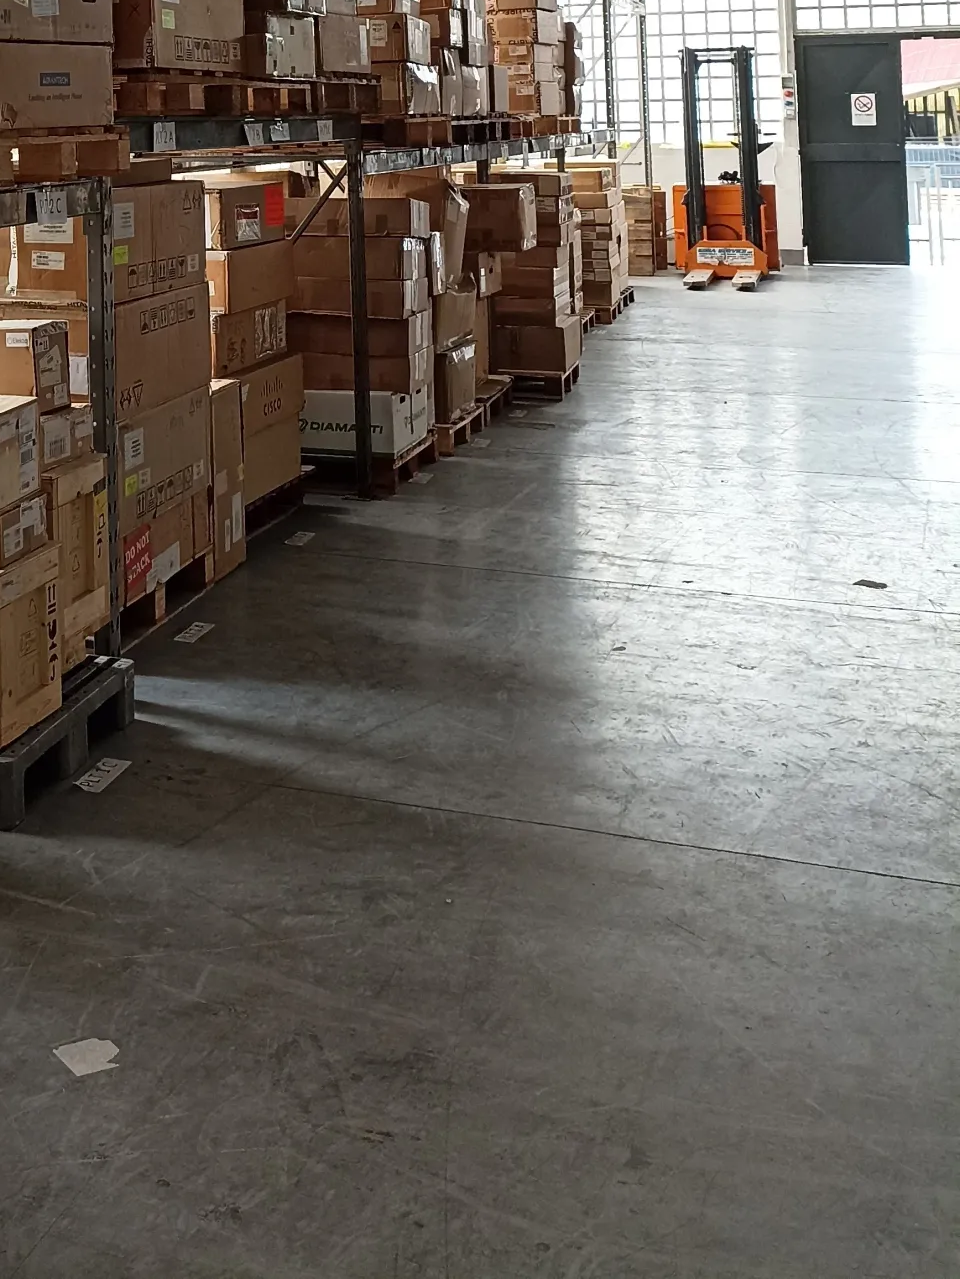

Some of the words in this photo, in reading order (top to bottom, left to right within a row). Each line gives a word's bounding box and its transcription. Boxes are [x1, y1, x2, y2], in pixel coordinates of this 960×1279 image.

[263, 397, 282, 417] CISCO
[310, 421, 384, 435] DIAMATI
[125, 544, 137, 561] DO
[137, 530, 151, 554] NOT
[127, 552, 152, 582] STACK
